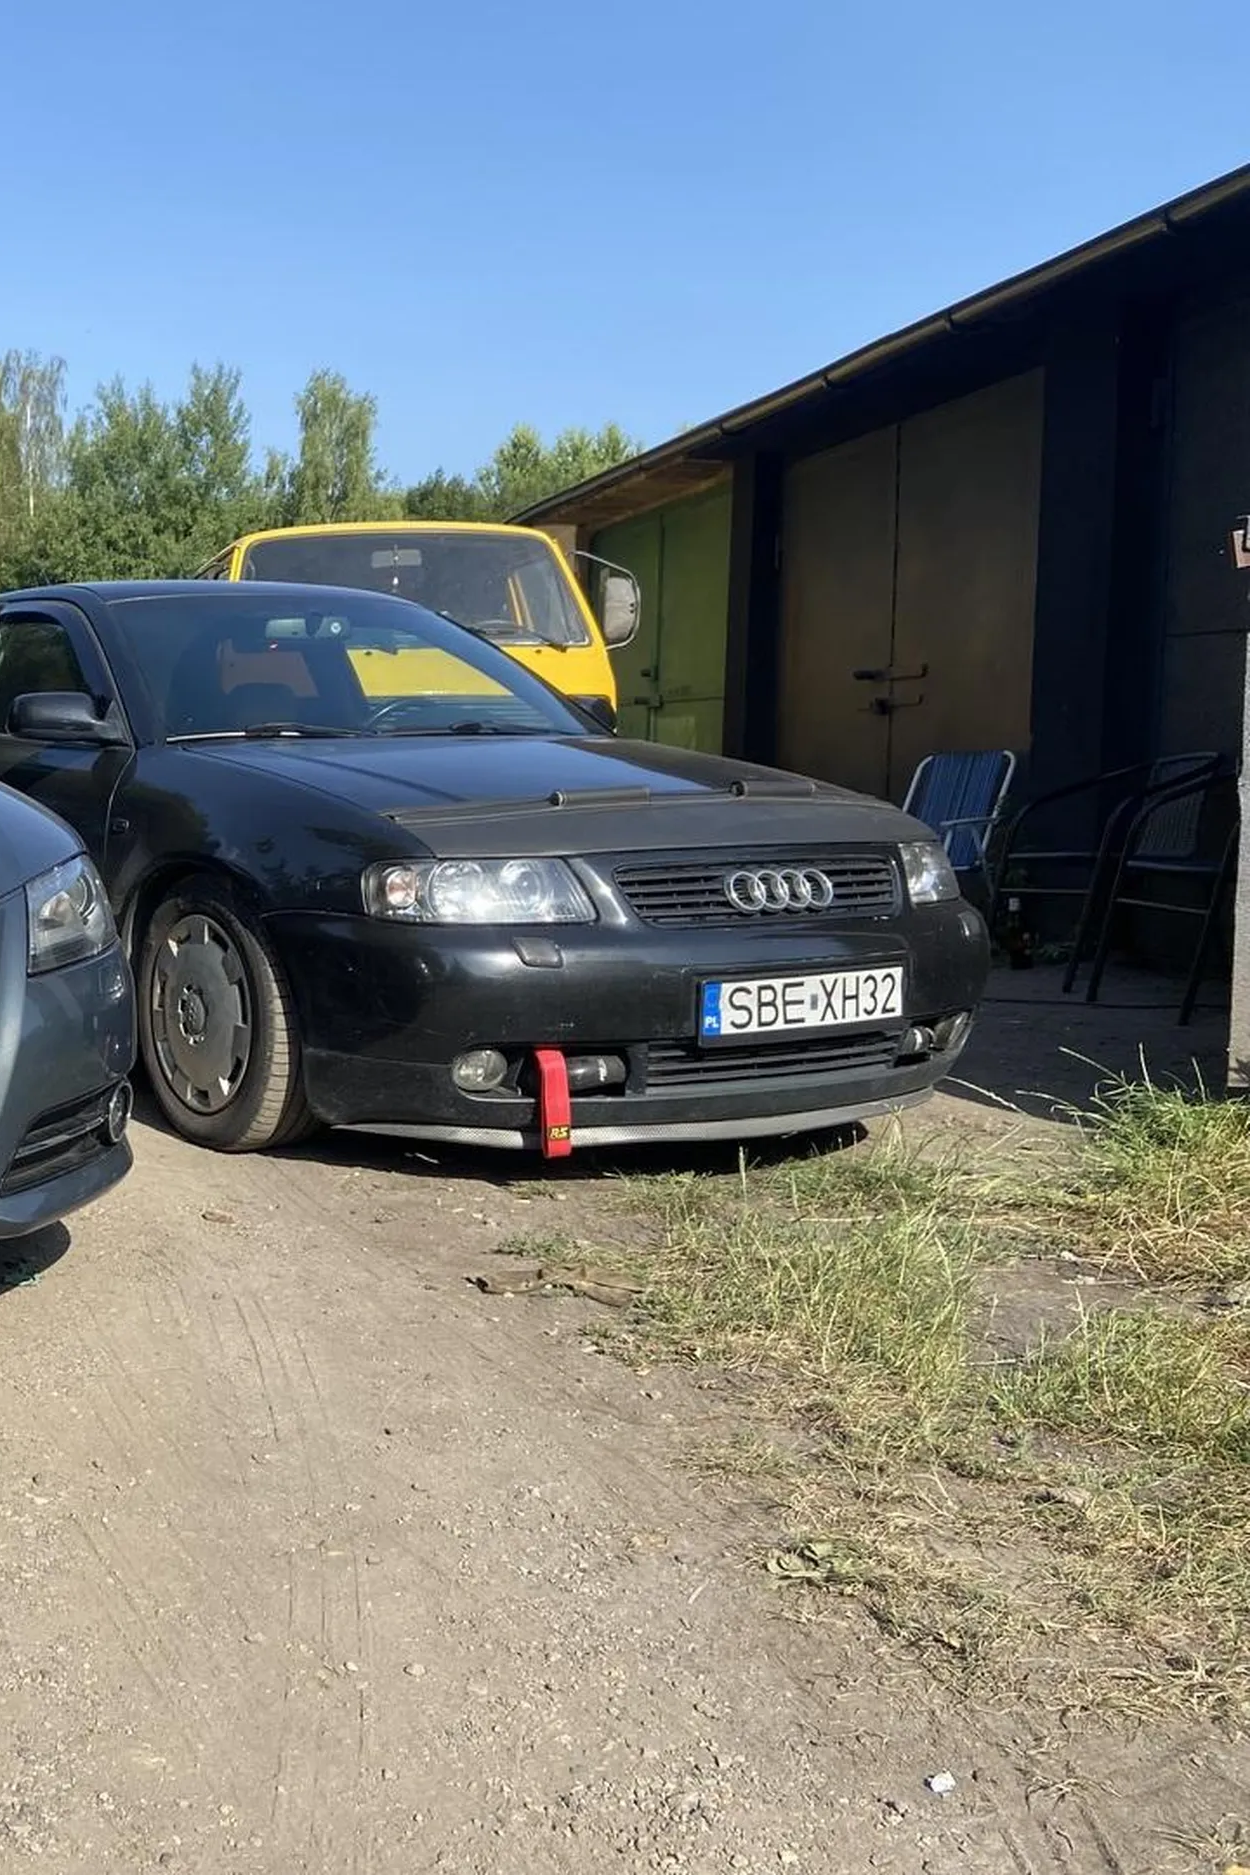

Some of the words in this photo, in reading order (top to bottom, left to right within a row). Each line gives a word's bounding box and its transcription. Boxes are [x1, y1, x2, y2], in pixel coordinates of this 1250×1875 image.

[728, 982, 805, 1029] SBE
[820, 973, 896, 1022] XH32
[705, 1018, 719, 1029] PL
